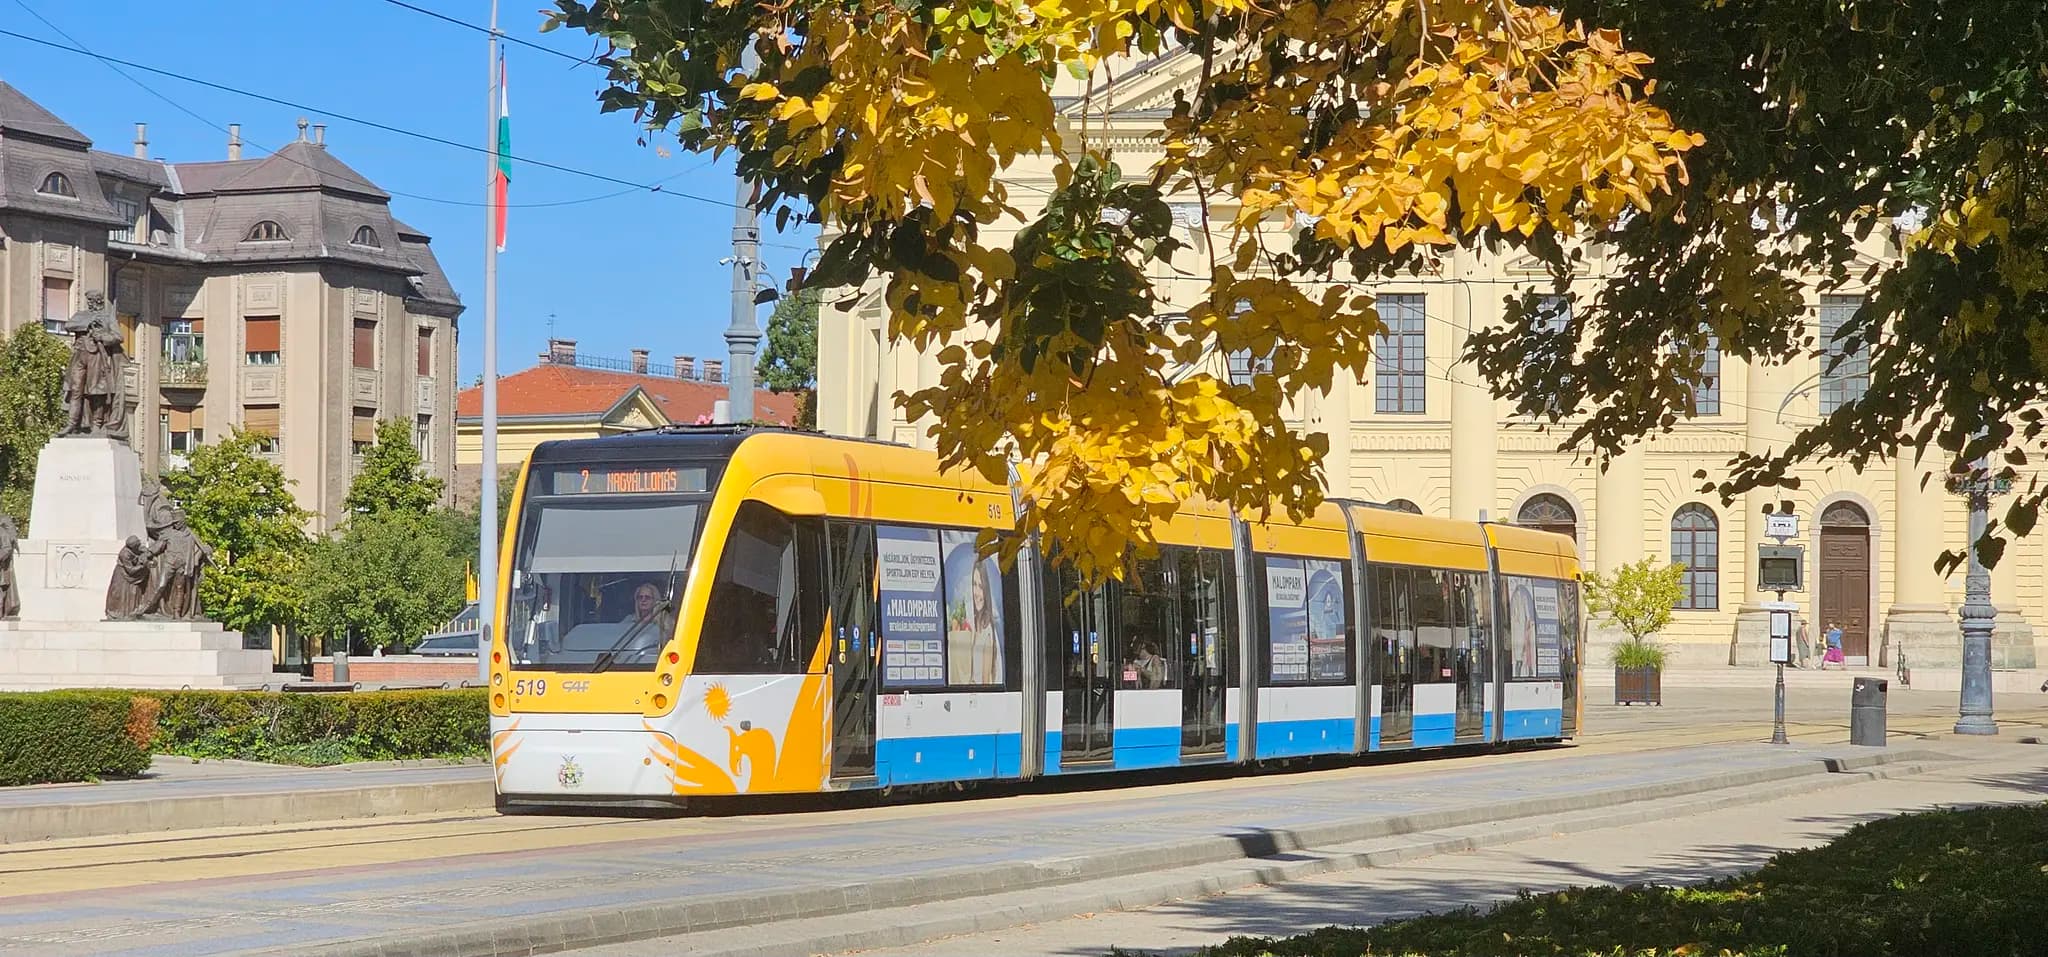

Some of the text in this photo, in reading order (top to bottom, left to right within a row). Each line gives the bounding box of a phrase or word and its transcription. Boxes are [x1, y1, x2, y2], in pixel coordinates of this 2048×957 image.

[581, 468, 677, 492] 2 NAGYÁLLOMÁS
[988, 503, 1001, 520] 519
[891, 599, 938, 618] MALOMPARK
[515, 679, 590, 696] 519 CAF
